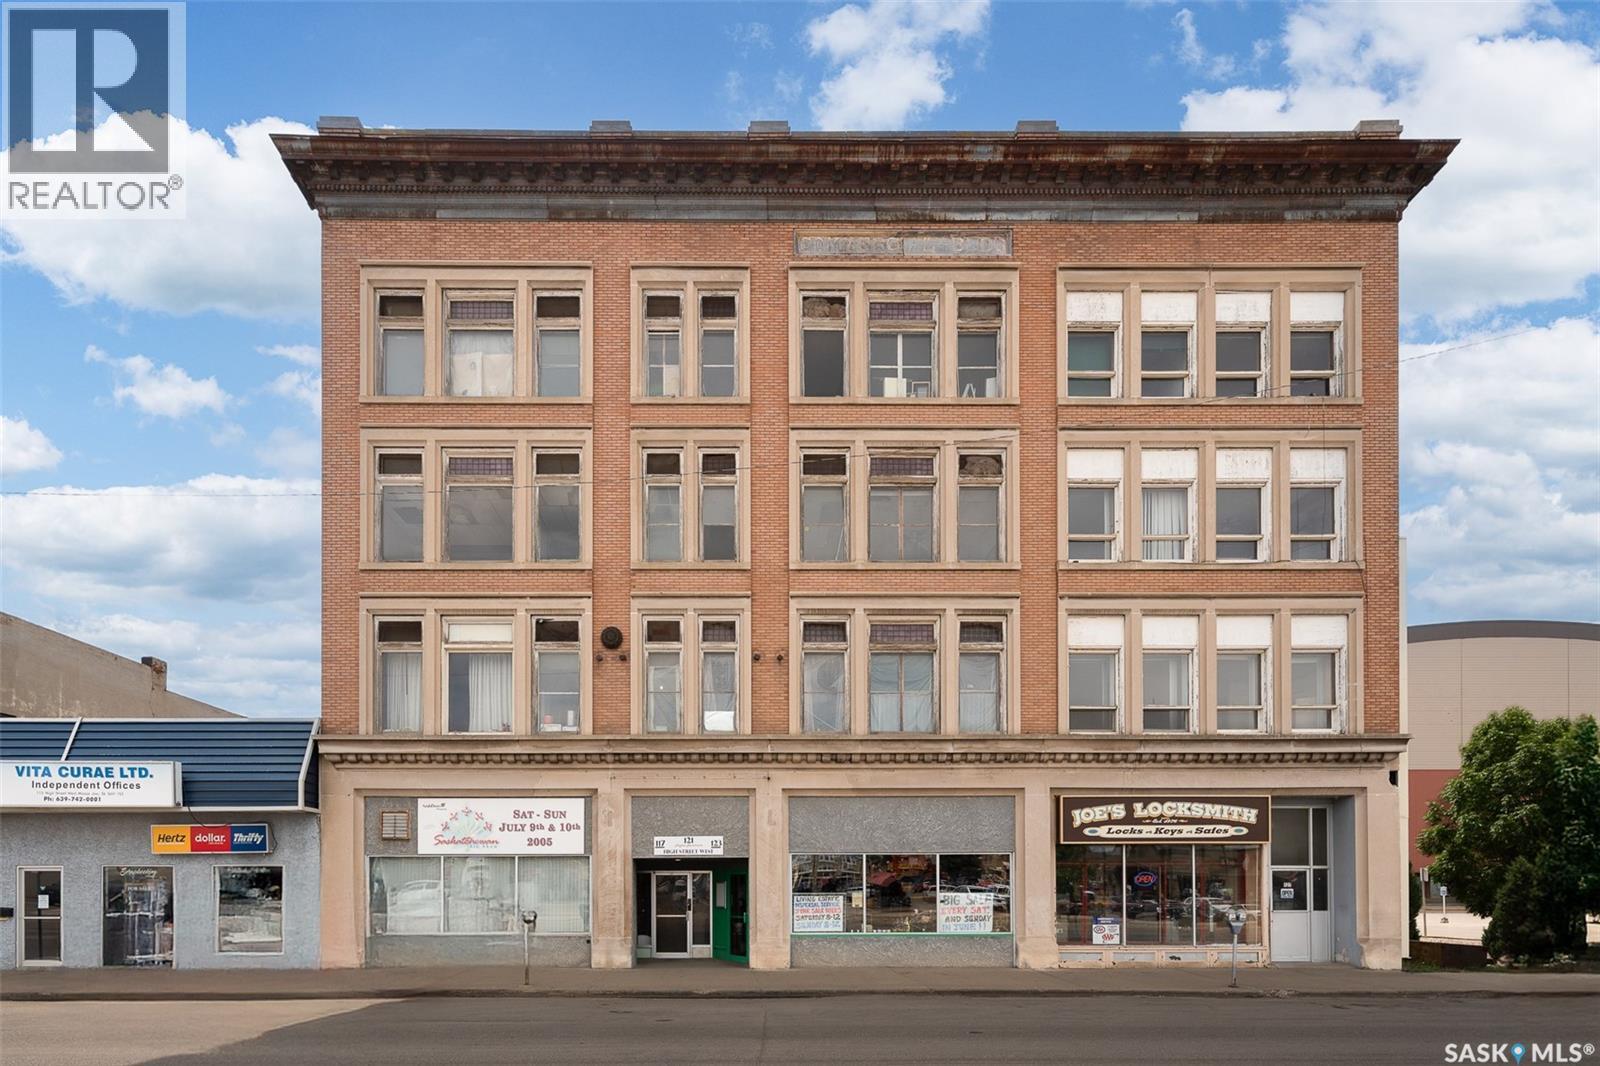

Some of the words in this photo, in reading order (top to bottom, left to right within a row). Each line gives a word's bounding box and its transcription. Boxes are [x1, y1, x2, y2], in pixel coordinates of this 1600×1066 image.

[15, 766, 52, 777] VITA
[58, 766, 115, 778] CURAE
[120, 766, 154, 778] LTD.
[31, 780, 101, 790] Independent
[103, 780, 142, 789] Offices
[513, 809, 535, 819] SAT
[543, 809, 567, 819] SUN
[1071, 803, 1127, 828] JOE'S
[1133, 801, 1259, 825] LOCKSMITH
[498, 822, 527, 832] JULY
[529, 823, 545, 832] 9th
[547, 823, 556, 832] &
[560, 823, 581, 832] 10th
[1106, 827, 1144, 835] Locks
[1153, 827, 1184, 836] Keys
[157, 833, 187, 843] Hertz
[232, 832, 264, 845] Thrifty
[527, 837, 553, 847] 2005
[683, 836, 694, 844] 121
[942, 894, 961, 906] BIG
[944, 915, 962, 923] AND
